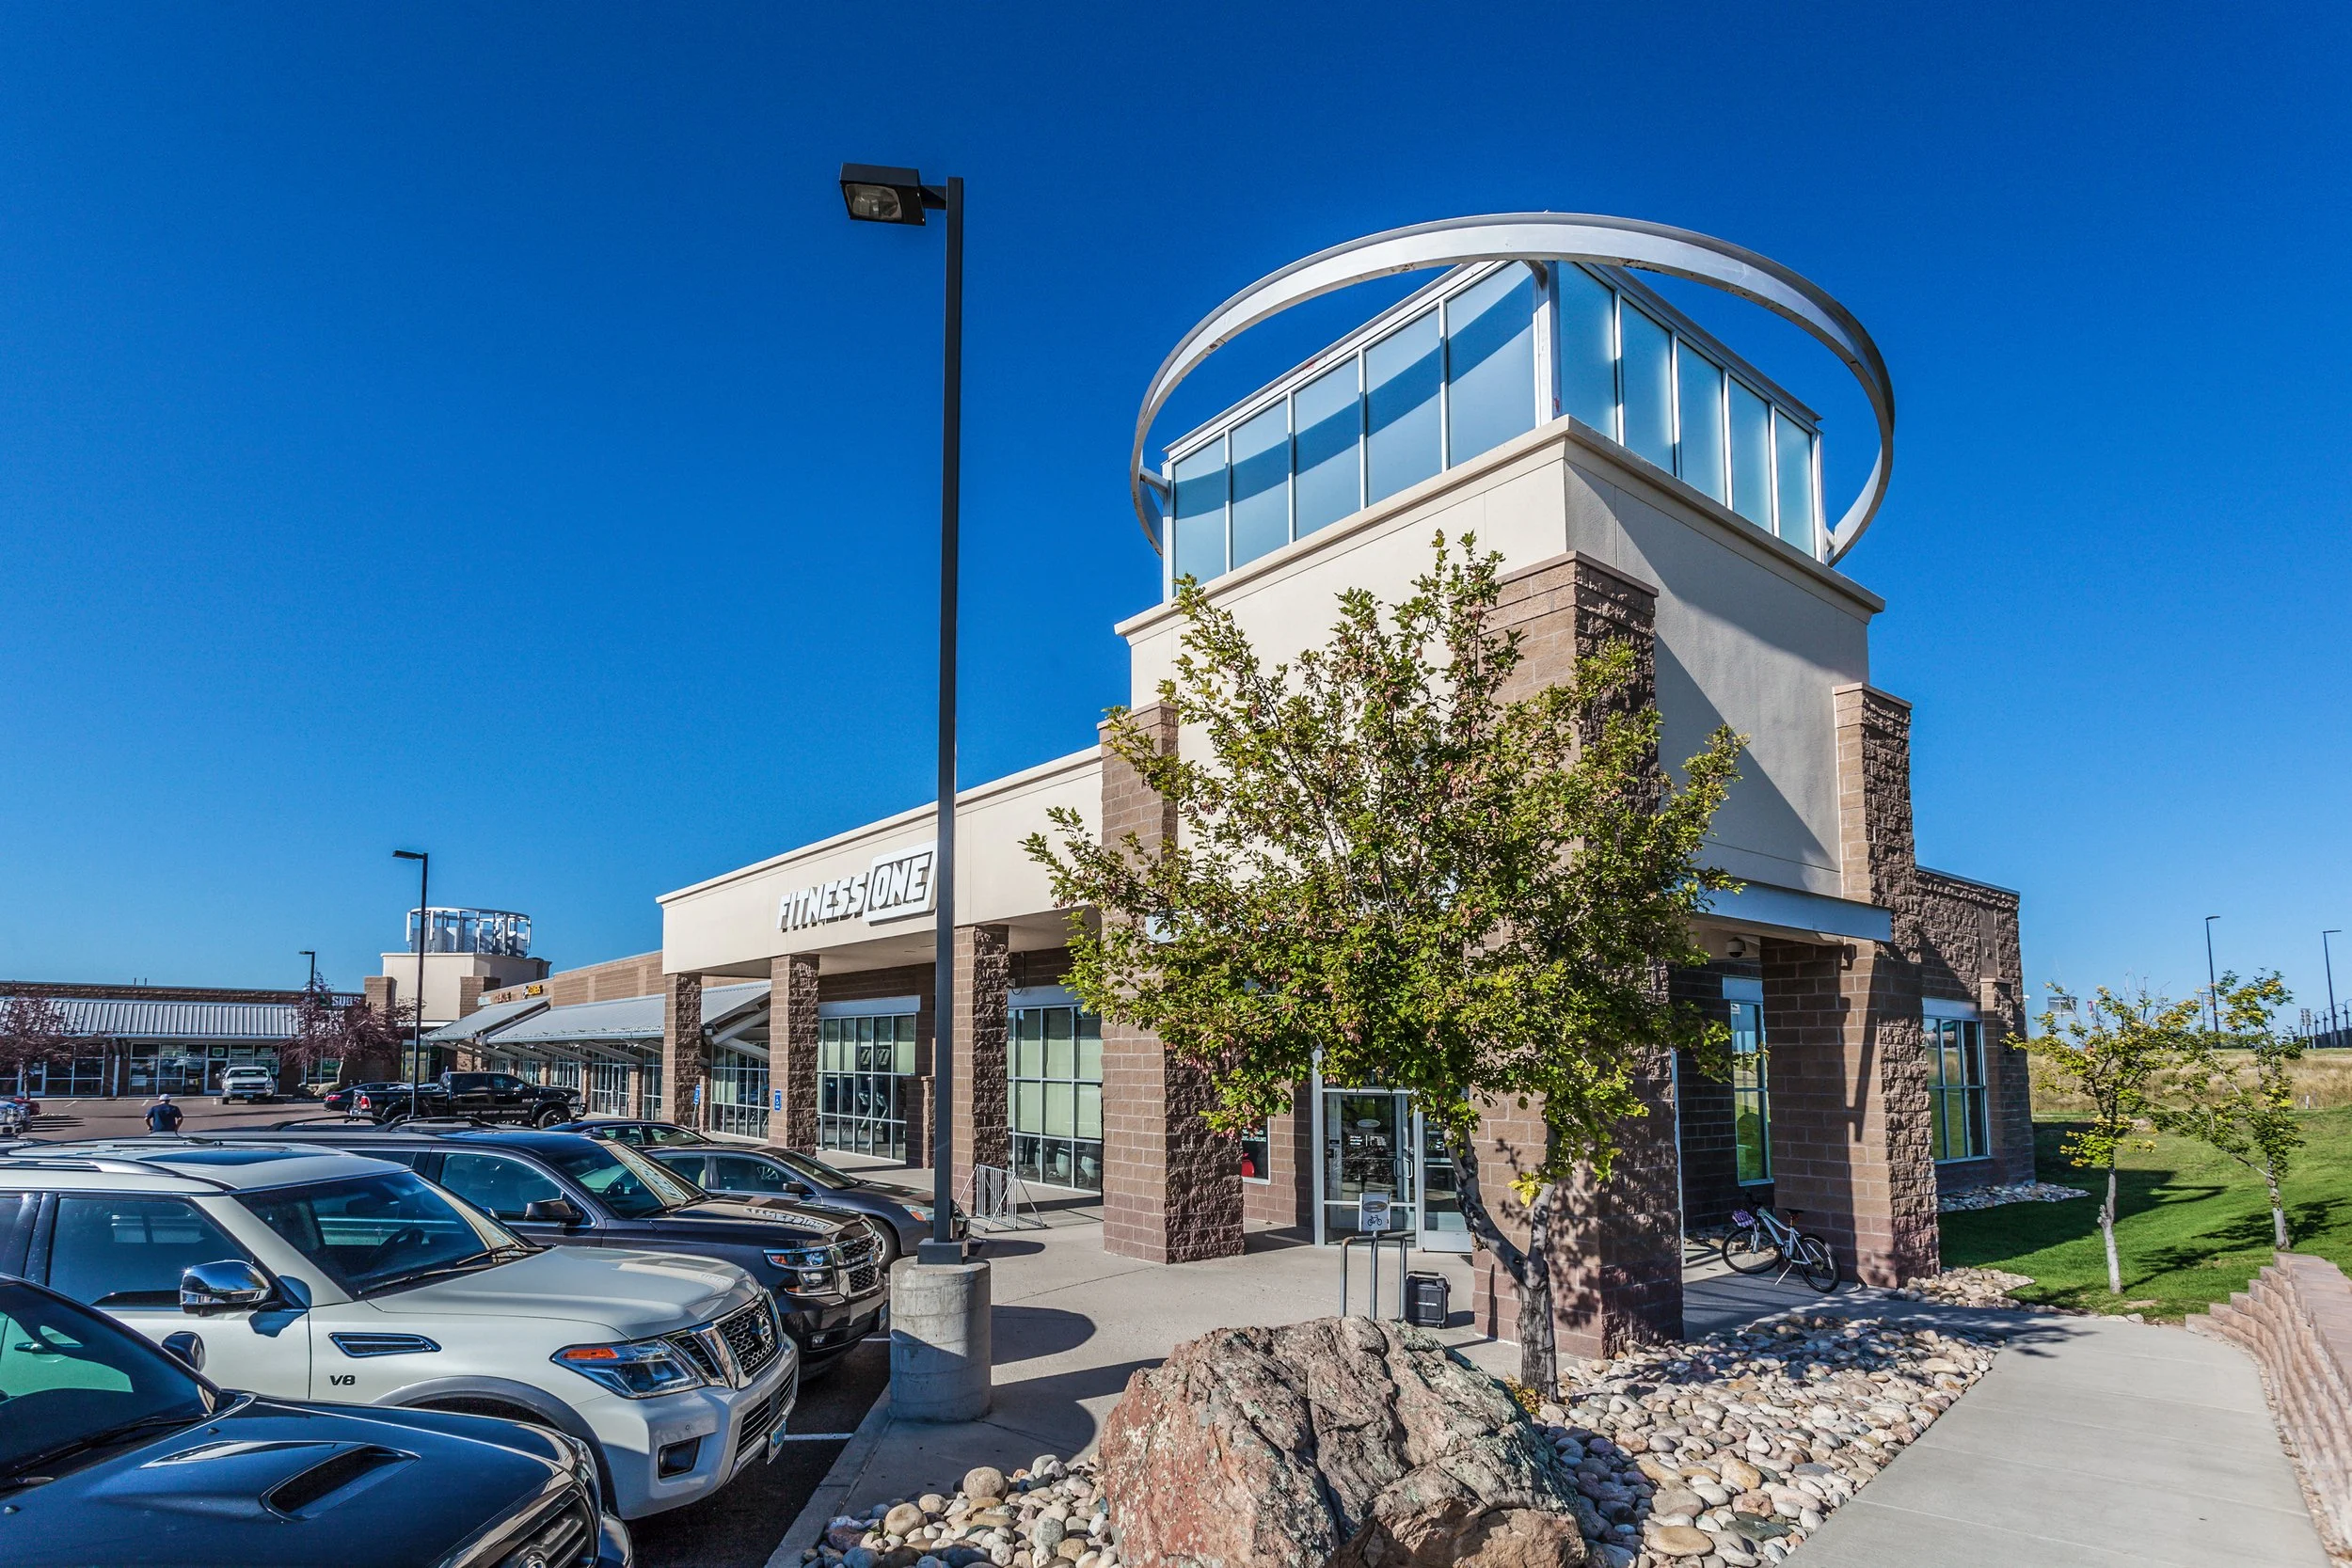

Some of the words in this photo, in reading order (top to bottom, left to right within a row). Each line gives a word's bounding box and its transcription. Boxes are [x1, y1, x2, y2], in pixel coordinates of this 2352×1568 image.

[775, 872, 868, 929] FITNESS
[870, 852, 932, 909] ONE
[329, 1375, 356, 1386] V8
